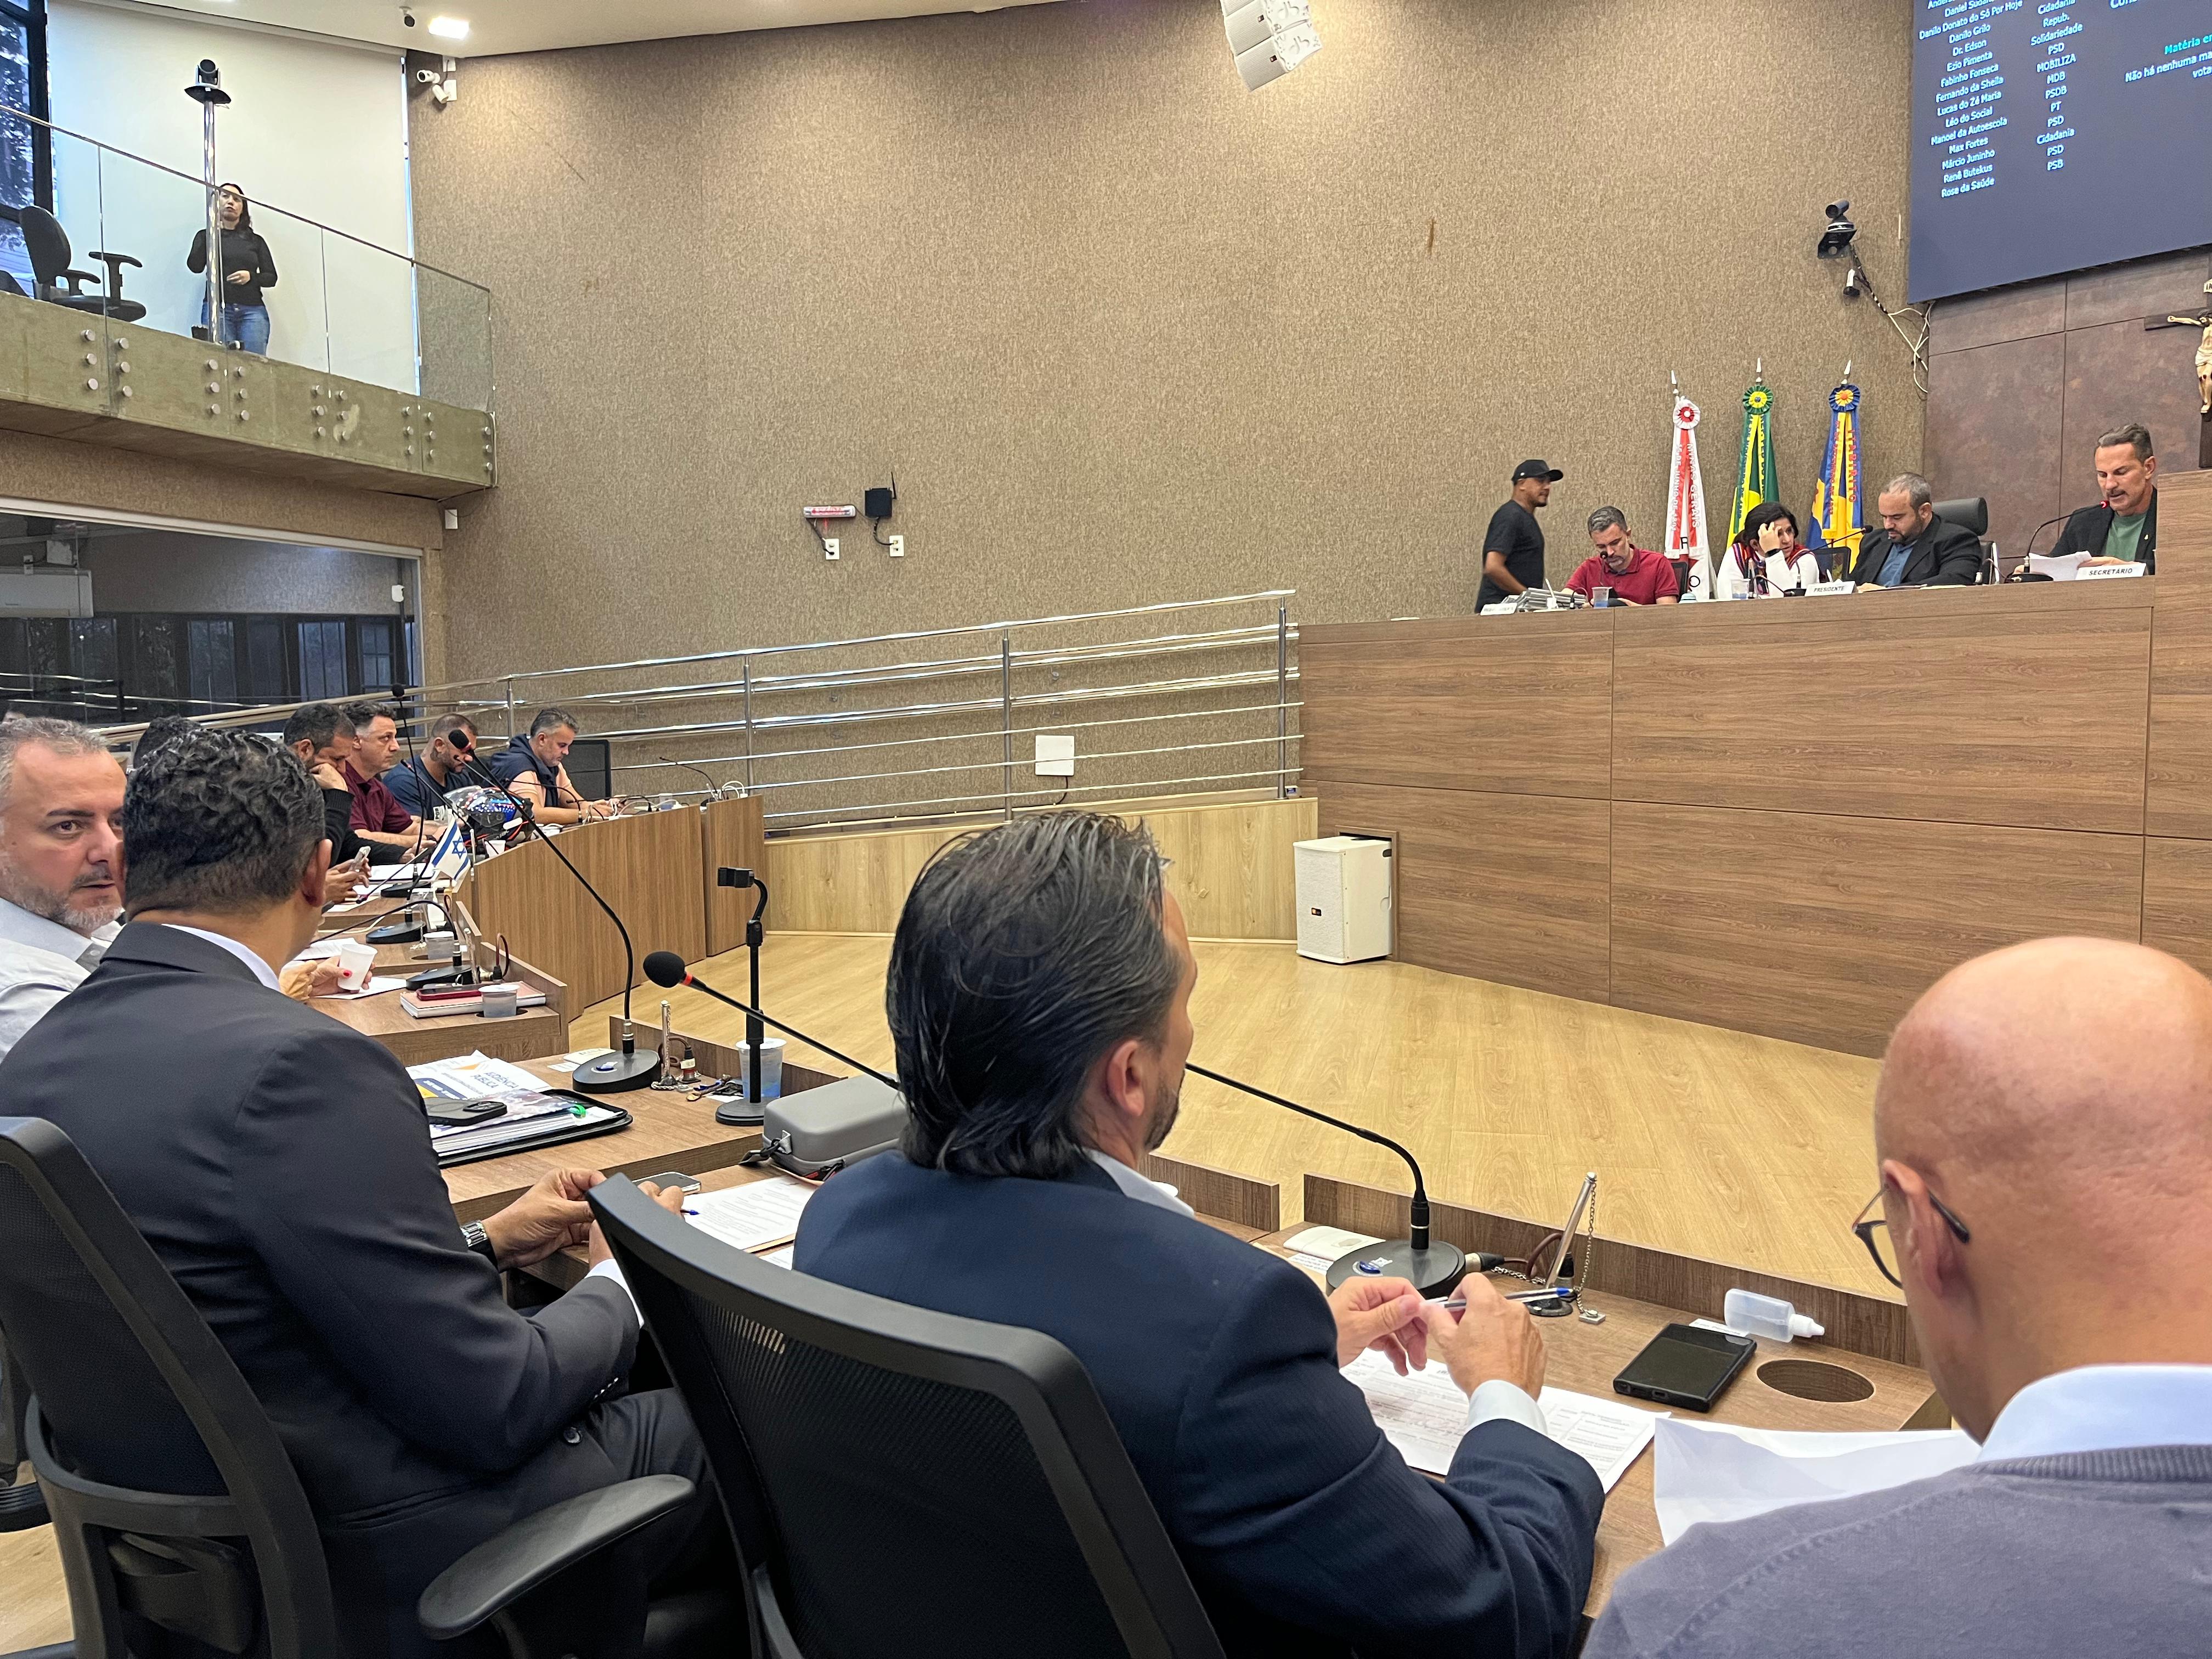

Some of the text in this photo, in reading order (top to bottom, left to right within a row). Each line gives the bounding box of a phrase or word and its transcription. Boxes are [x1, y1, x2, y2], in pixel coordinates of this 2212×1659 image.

[1944, 2, 1967, 18] Daniel
[1919, 0, 2023, 40] Danilo Donato do Só Por Hoje
[2043, 12, 2070, 27] Repub.
[1949, 24, 1991, 44] Danilo Grilo
[2030, 22, 2083, 46] Solidariedade
[1953, 40, 1987, 57] Dr. Edson
[2048, 42, 2065, 55] PSD
[2164, 37, 2200, 55] Matéria
[1963, 52, 1993, 67] Pimenta
[2036, 53, 2076, 72] MOBILIZA
[1940, 64, 1999, 88] Fabinho Fonseca
[2125, 70, 2142, 82] Não
[2143, 65, 2155, 77] há
[2157, 55, 2197, 74] nenhuma
[2047, 71, 2066, 84] MDB
[1936, 76, 2004, 103] Fernando da Sheila
[2045, 85, 2067, 99] PSDB
[1937, 91, 2002, 116] Lucas do Zé Maria
[2051, 101, 2062, 112] PT
[1945, 106, 1993, 128] Léo do Social
[2047, 115, 2064, 127] PSD
[1931, 117, 2008, 145] Manoel da Autoescola
[2036, 128, 2075, 145] Cidadania
[1949, 137, 1989, 154] Max Fortes
[2047, 144, 2064, 156] PSD
[1942, 149, 1996, 170] Márcio Juninho
[2047, 159, 2064, 171] PSB
[1963, 164, 1993, 178] Butekus
[1941, 177, 1995, 198] Rose da Saúde
[1675, 455, 1682, 466] DE
[1848, 430, 1857, 503] ITABIRITO
[1686, 443, 1700, 528] MINAS GERAIS
[1672, 500, 1678, 512] DE
[2089, 567, 2133, 575] SECRETÁRIO
